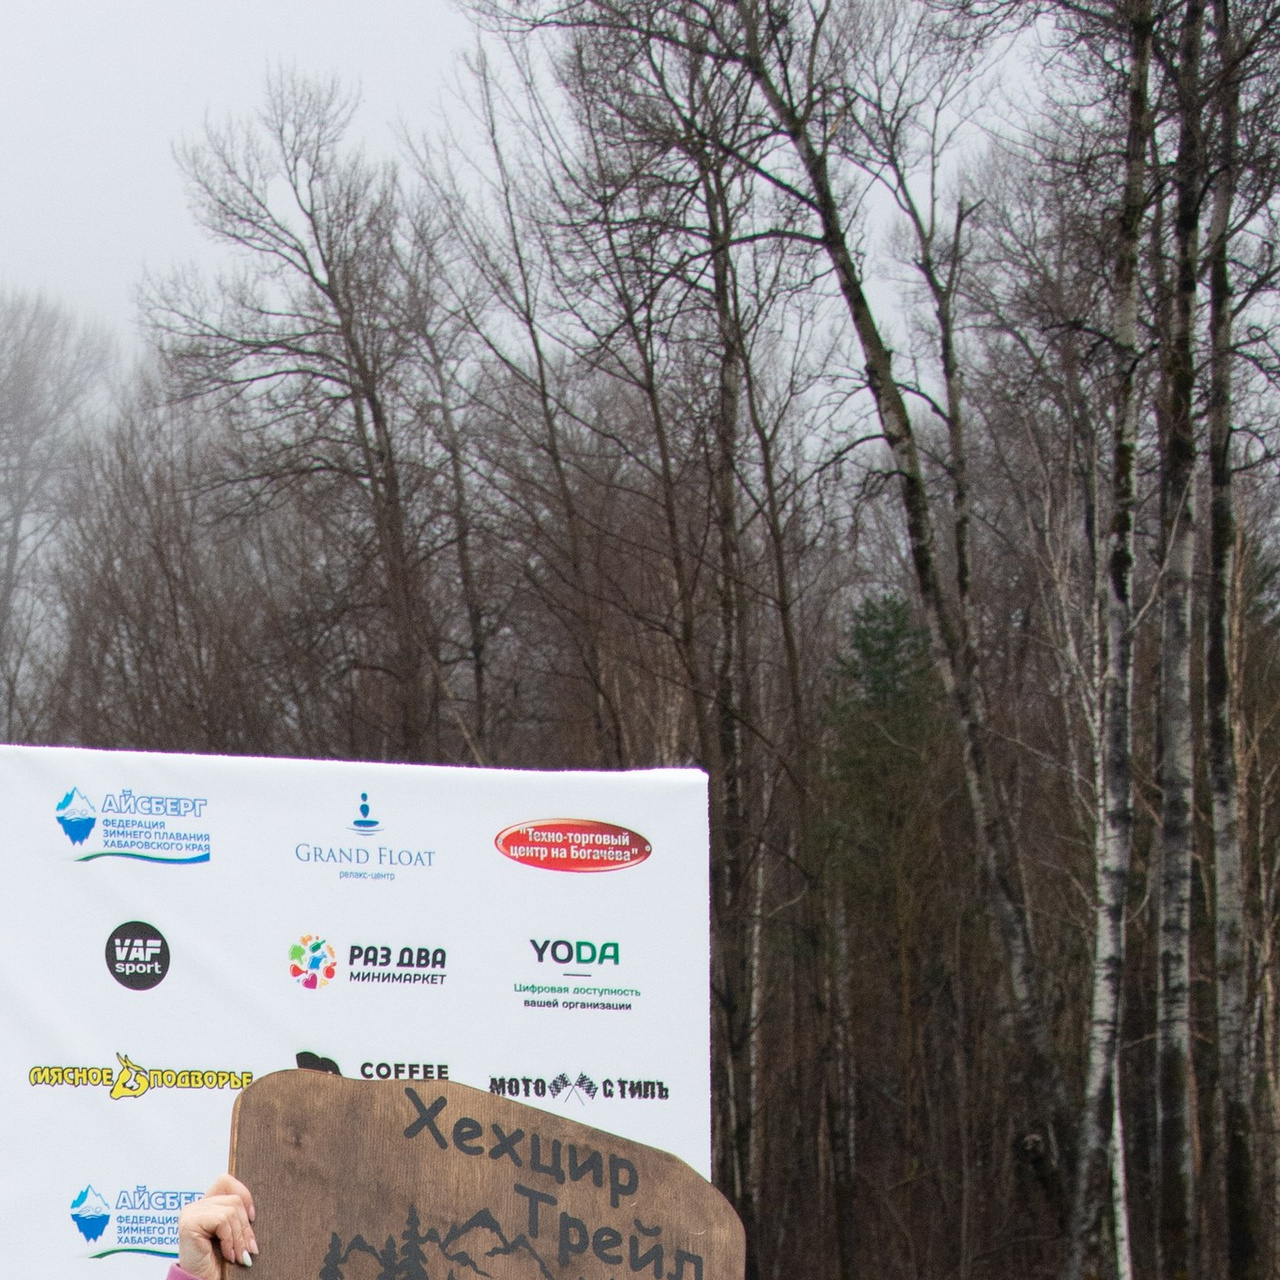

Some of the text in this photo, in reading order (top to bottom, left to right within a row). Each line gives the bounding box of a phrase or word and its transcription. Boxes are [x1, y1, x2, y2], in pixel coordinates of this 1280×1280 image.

[101, 789, 208, 817] АЙСБЕРГ
[102, 819, 165, 829] ФЕДЕРАЦИЯ
[103, 829, 210, 842] ЗИМНЕГО ПЛАВАНИЯ
[103, 840, 210, 852] ХАБАРОВСКОГО КРАЯ
[510, 846, 548, 860] центр
[551, 848, 567, 858] на
[115, 939, 162, 961] VAF
[349, 945, 446, 969] РАЗ ДВА
[530, 939, 619, 965] YODA
[115, 962, 162, 975] sport
[349, 972, 447, 985] МИНИМАРКЕТ
[514, 983, 641, 997] Цифровая доступность
[524, 999, 632, 1010] вашей организации
[29, 1066, 253, 1089] МЯСНОЕ ПОДВОРЬЕ
[361, 1062, 449, 1080] COFFEE
[489, 1077, 547, 1098] МОТО
[404, 1087, 639, 1208] Хехцир
[116, 1215, 179, 1225] ФЕДЕРАЦИЯ
[117, 1226, 165, 1236] ЗИМНЕГО
